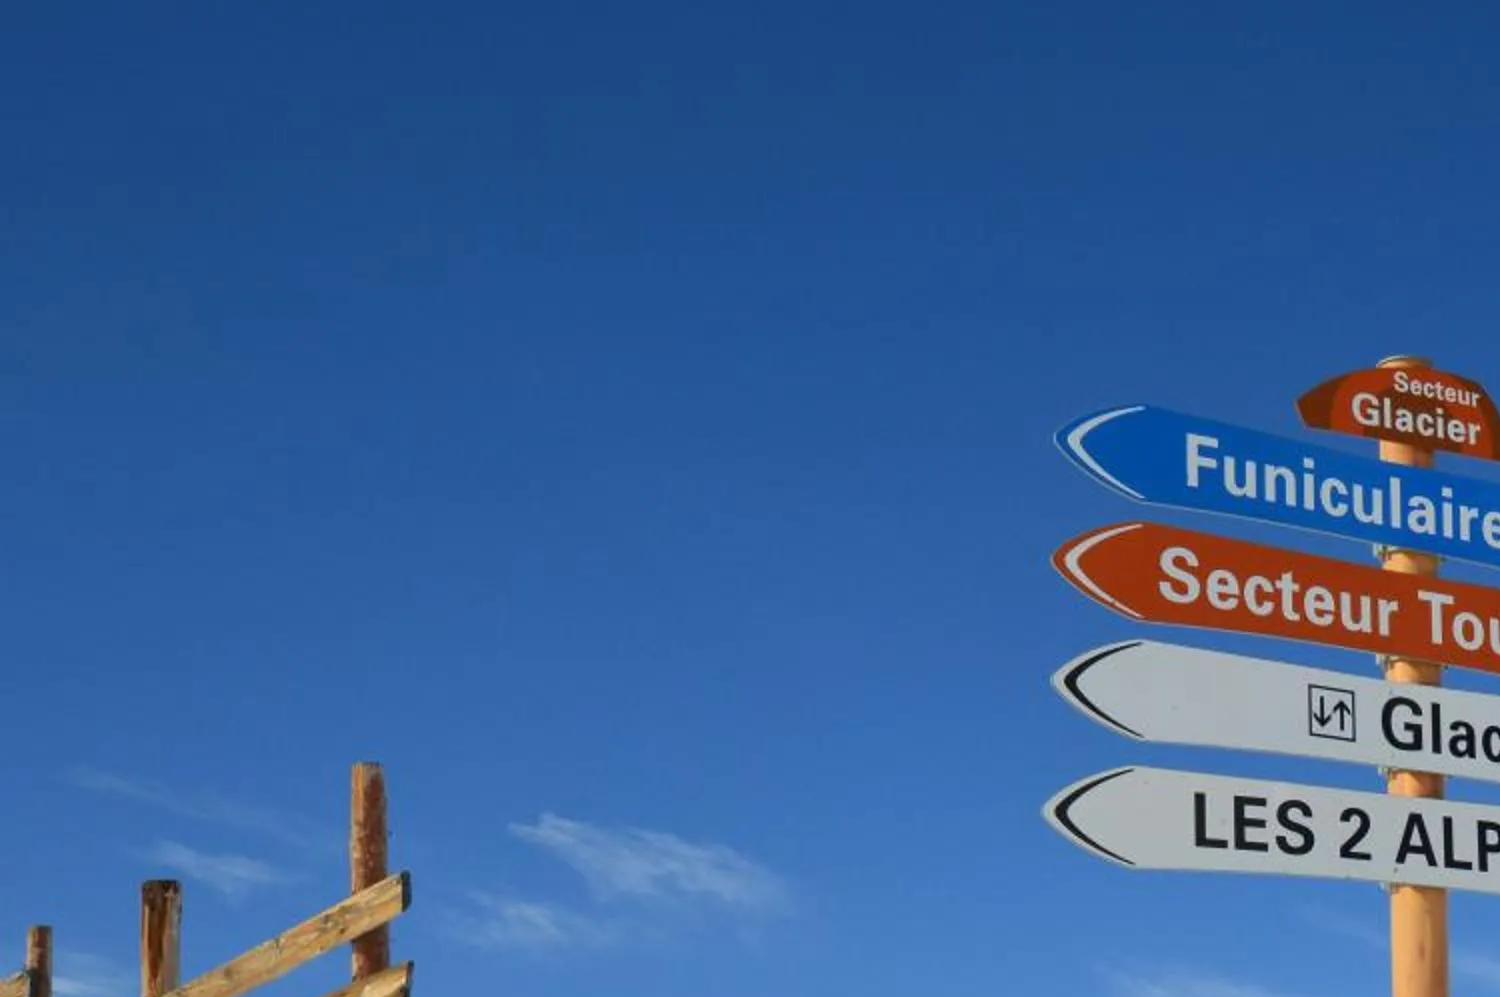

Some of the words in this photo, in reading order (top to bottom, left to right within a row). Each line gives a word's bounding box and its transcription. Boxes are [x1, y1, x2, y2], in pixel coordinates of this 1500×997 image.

[1351, 392, 1482, 446] Glacier
[1393, 371, 1481, 409] Secteur
[1158, 546, 1399, 637] Secteur
[1193, 792, 1315, 856] LES
[1338, 807, 1373, 862] 2
